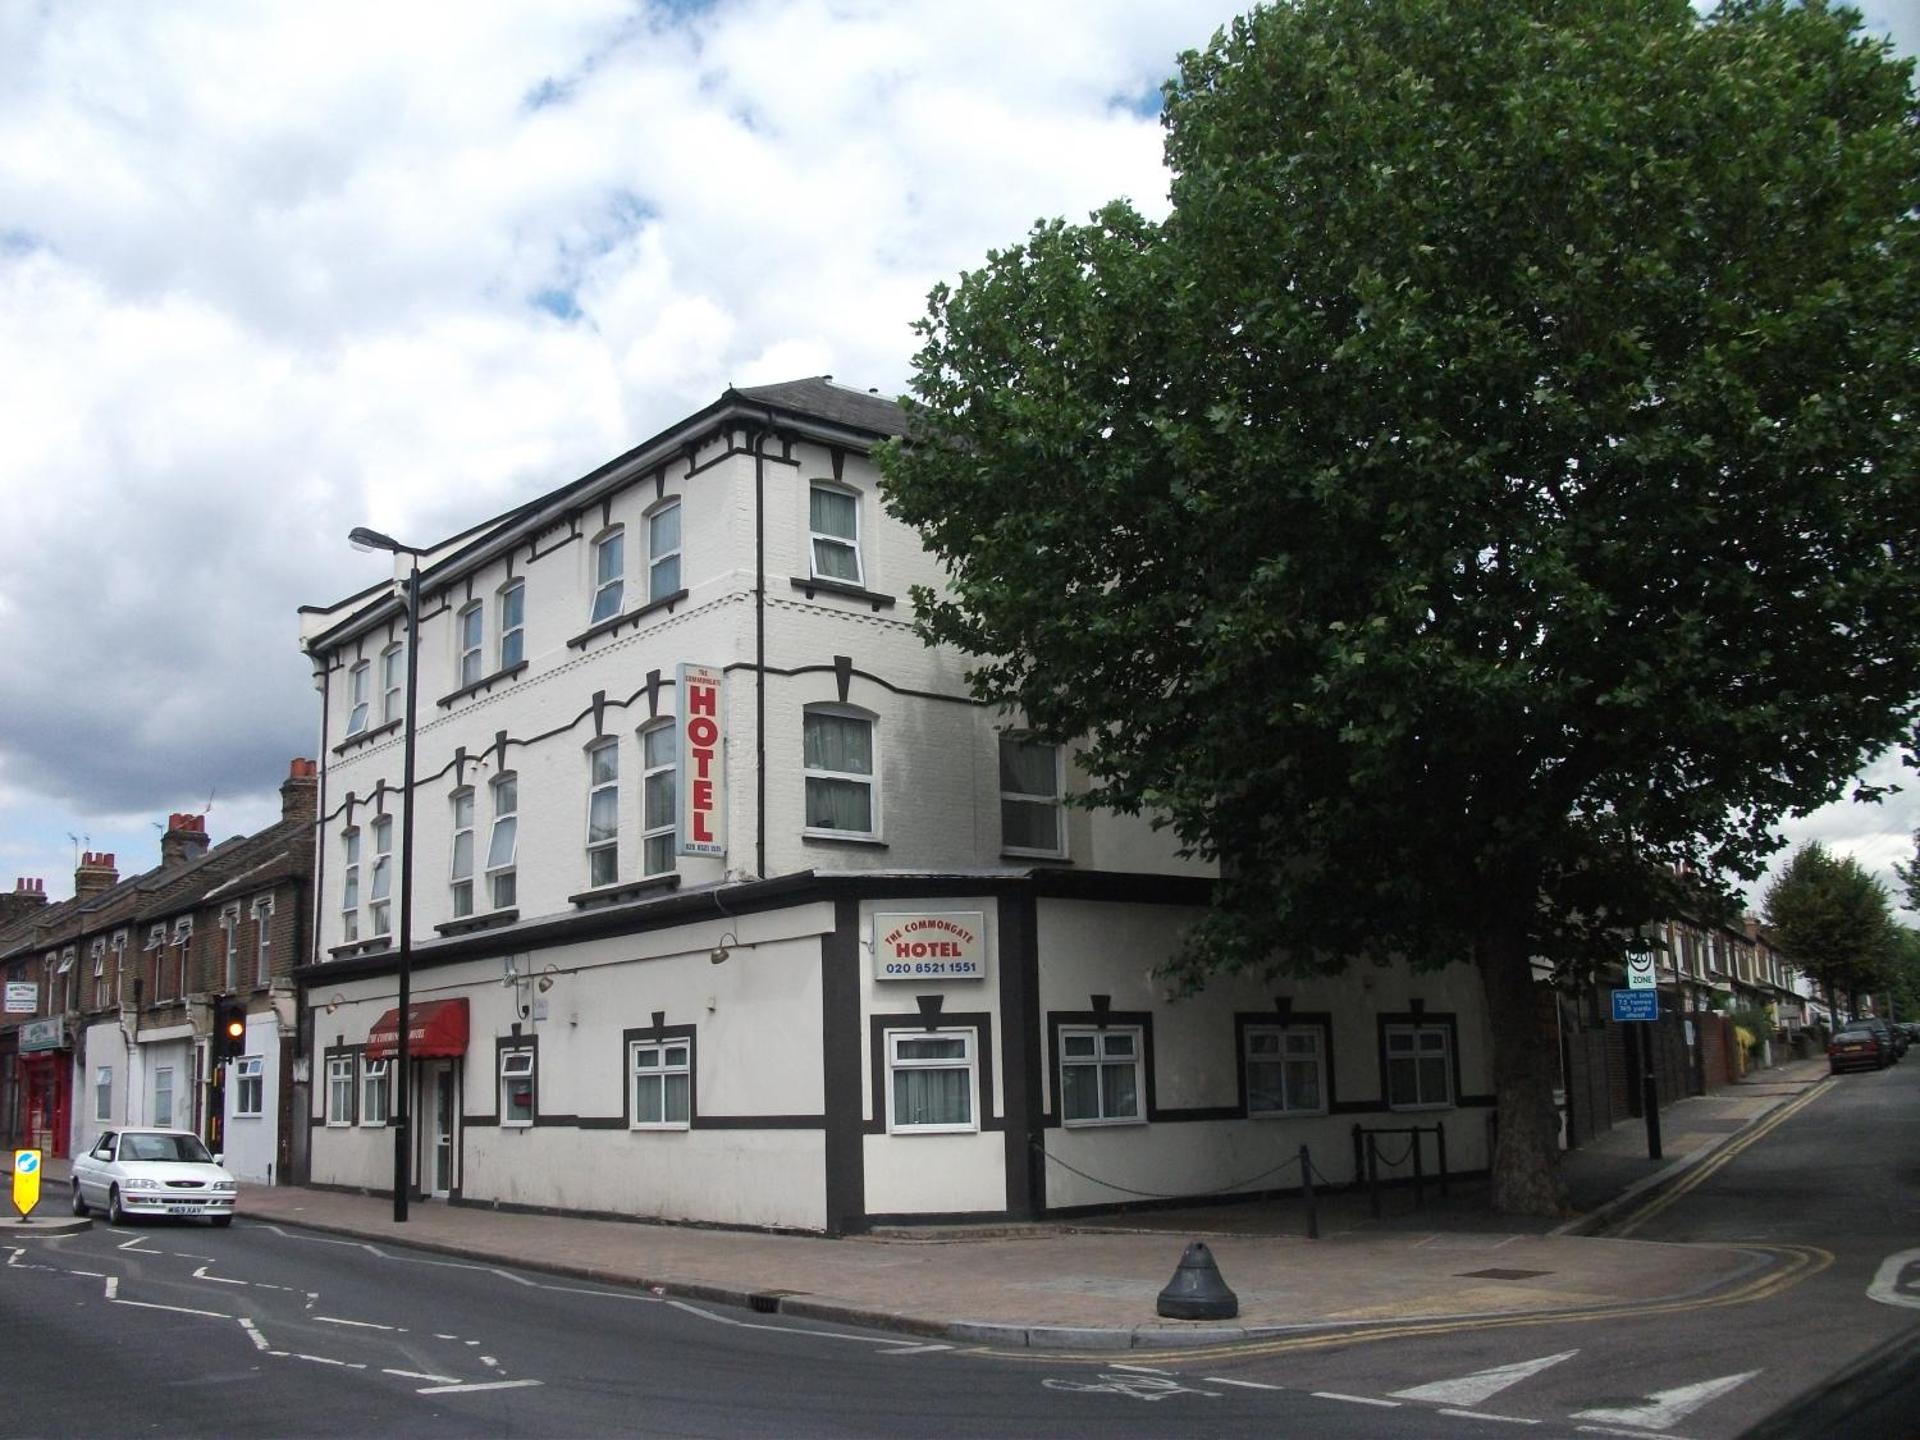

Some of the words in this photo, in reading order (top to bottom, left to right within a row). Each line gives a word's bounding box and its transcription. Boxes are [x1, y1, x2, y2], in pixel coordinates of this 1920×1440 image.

[688, 685, 718, 843] HOTEL
[884, 930, 903, 946] THE
[904, 919, 975, 944] COMMONGATE
[896, 941, 963, 958] HOTEL
[886, 963, 911, 974] 020
[915, 962, 946, 974] 8521
[949, 962, 977, 973] 1551
[1633, 975, 1653, 984] ZONE
